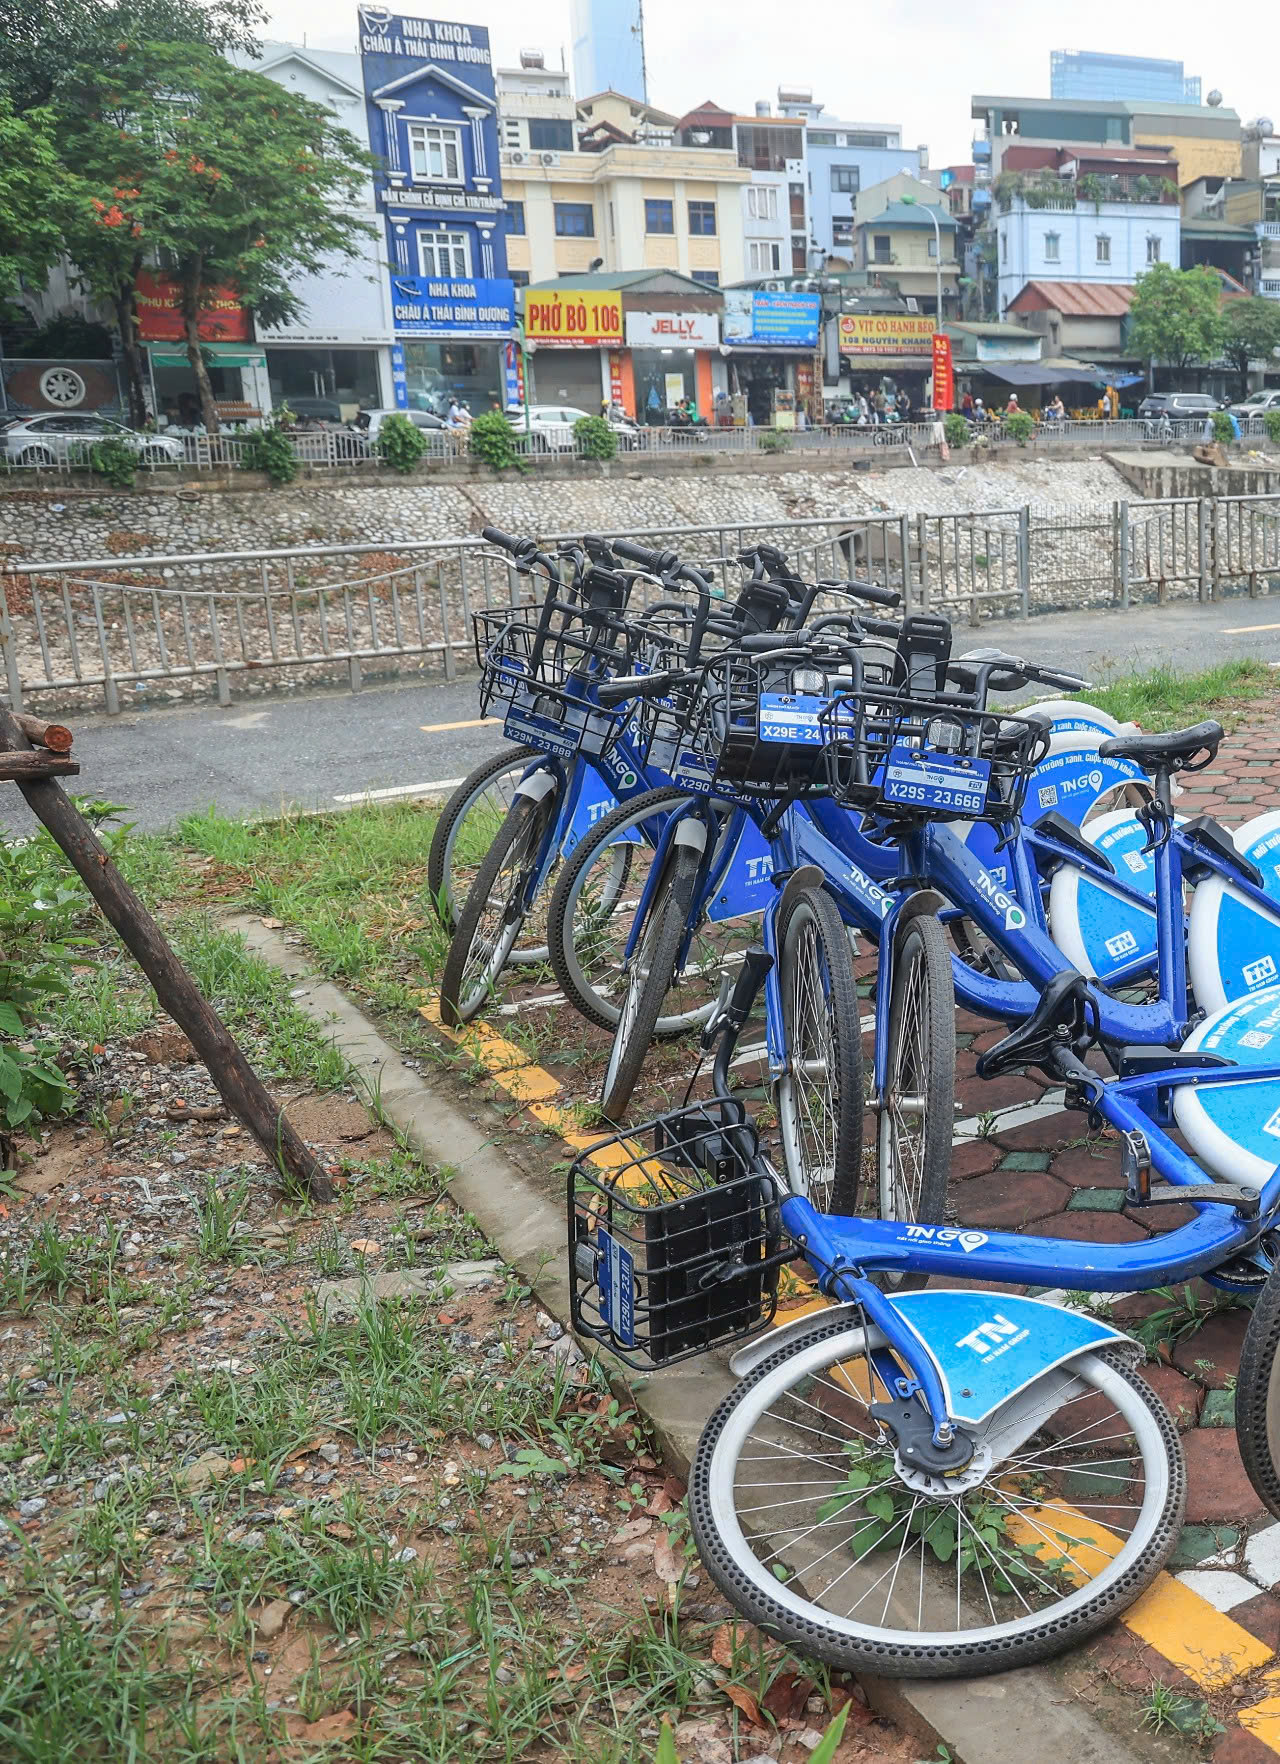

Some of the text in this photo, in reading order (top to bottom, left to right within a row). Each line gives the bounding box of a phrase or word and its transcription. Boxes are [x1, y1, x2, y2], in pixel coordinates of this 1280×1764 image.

[362, 34, 392, 53] CHÂU
[402, 19, 472, 45] NHA KHOA
[428, 282, 477, 299] NHA KHOA
[395, 302, 420, 320] CHÂU
[529, 292, 620, 332] PHỞ BÒ 106
[651, 319, 696, 334] JELLY
[507, 727, 572, 758] X29N-23.888
[889, 782, 981, 809] X29S-23.666
[955, 1314, 1019, 1355] TN
